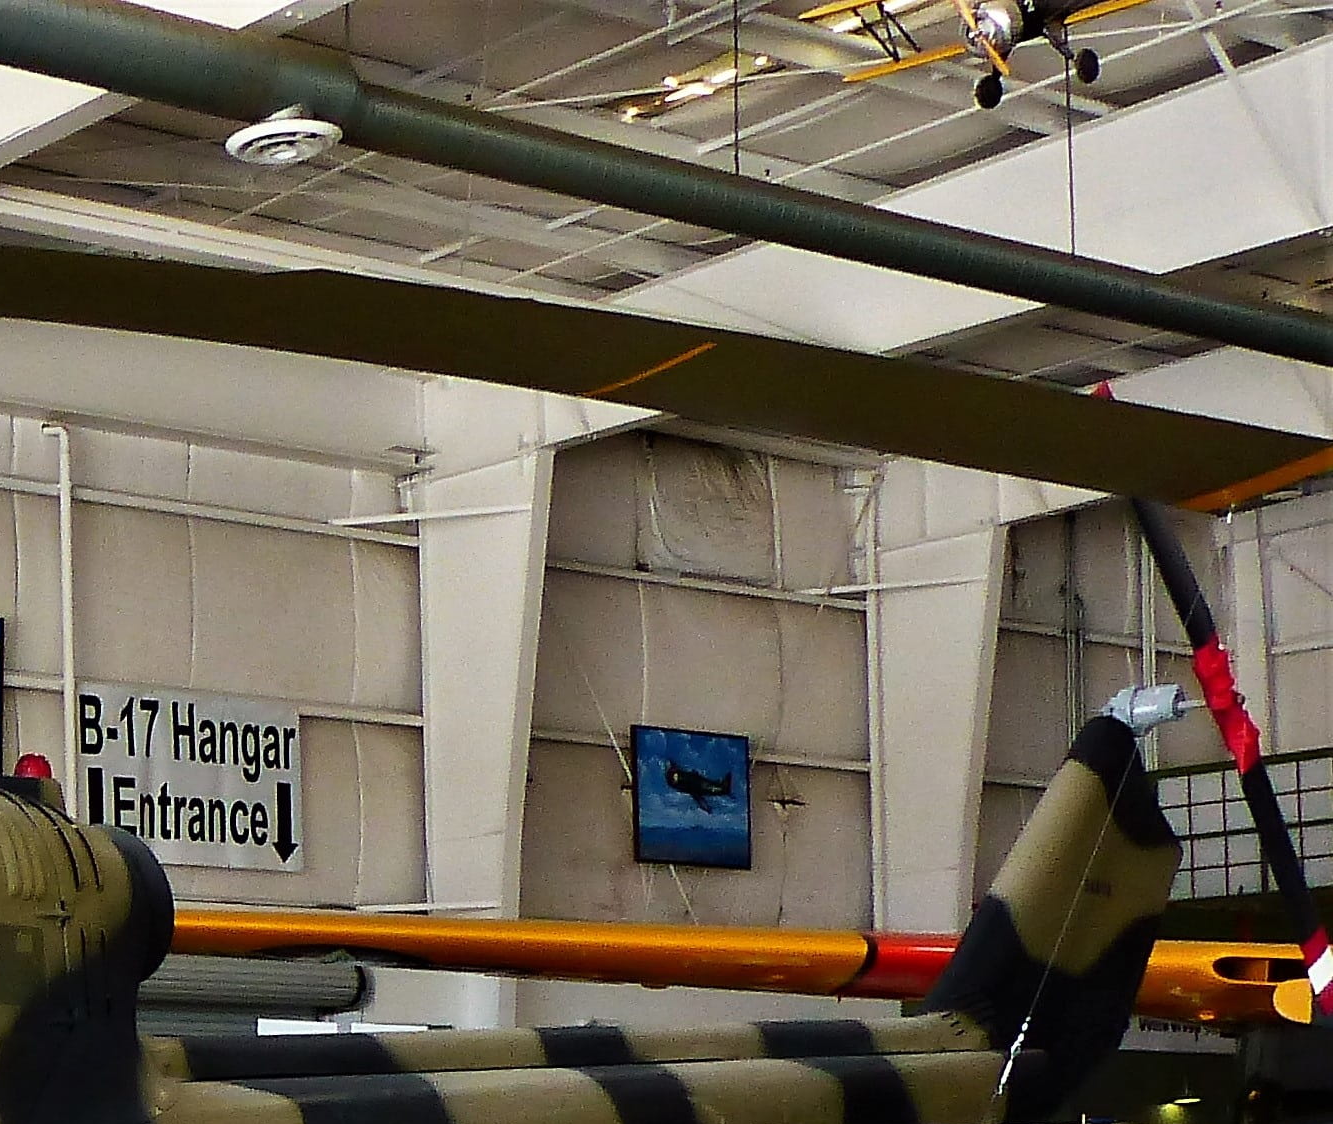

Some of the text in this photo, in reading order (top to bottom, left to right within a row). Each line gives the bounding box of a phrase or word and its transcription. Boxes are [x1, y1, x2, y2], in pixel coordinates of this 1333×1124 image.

[79, 694, 296, 783] B-17 Hangar
[113, 776, 269, 846] Entrance
